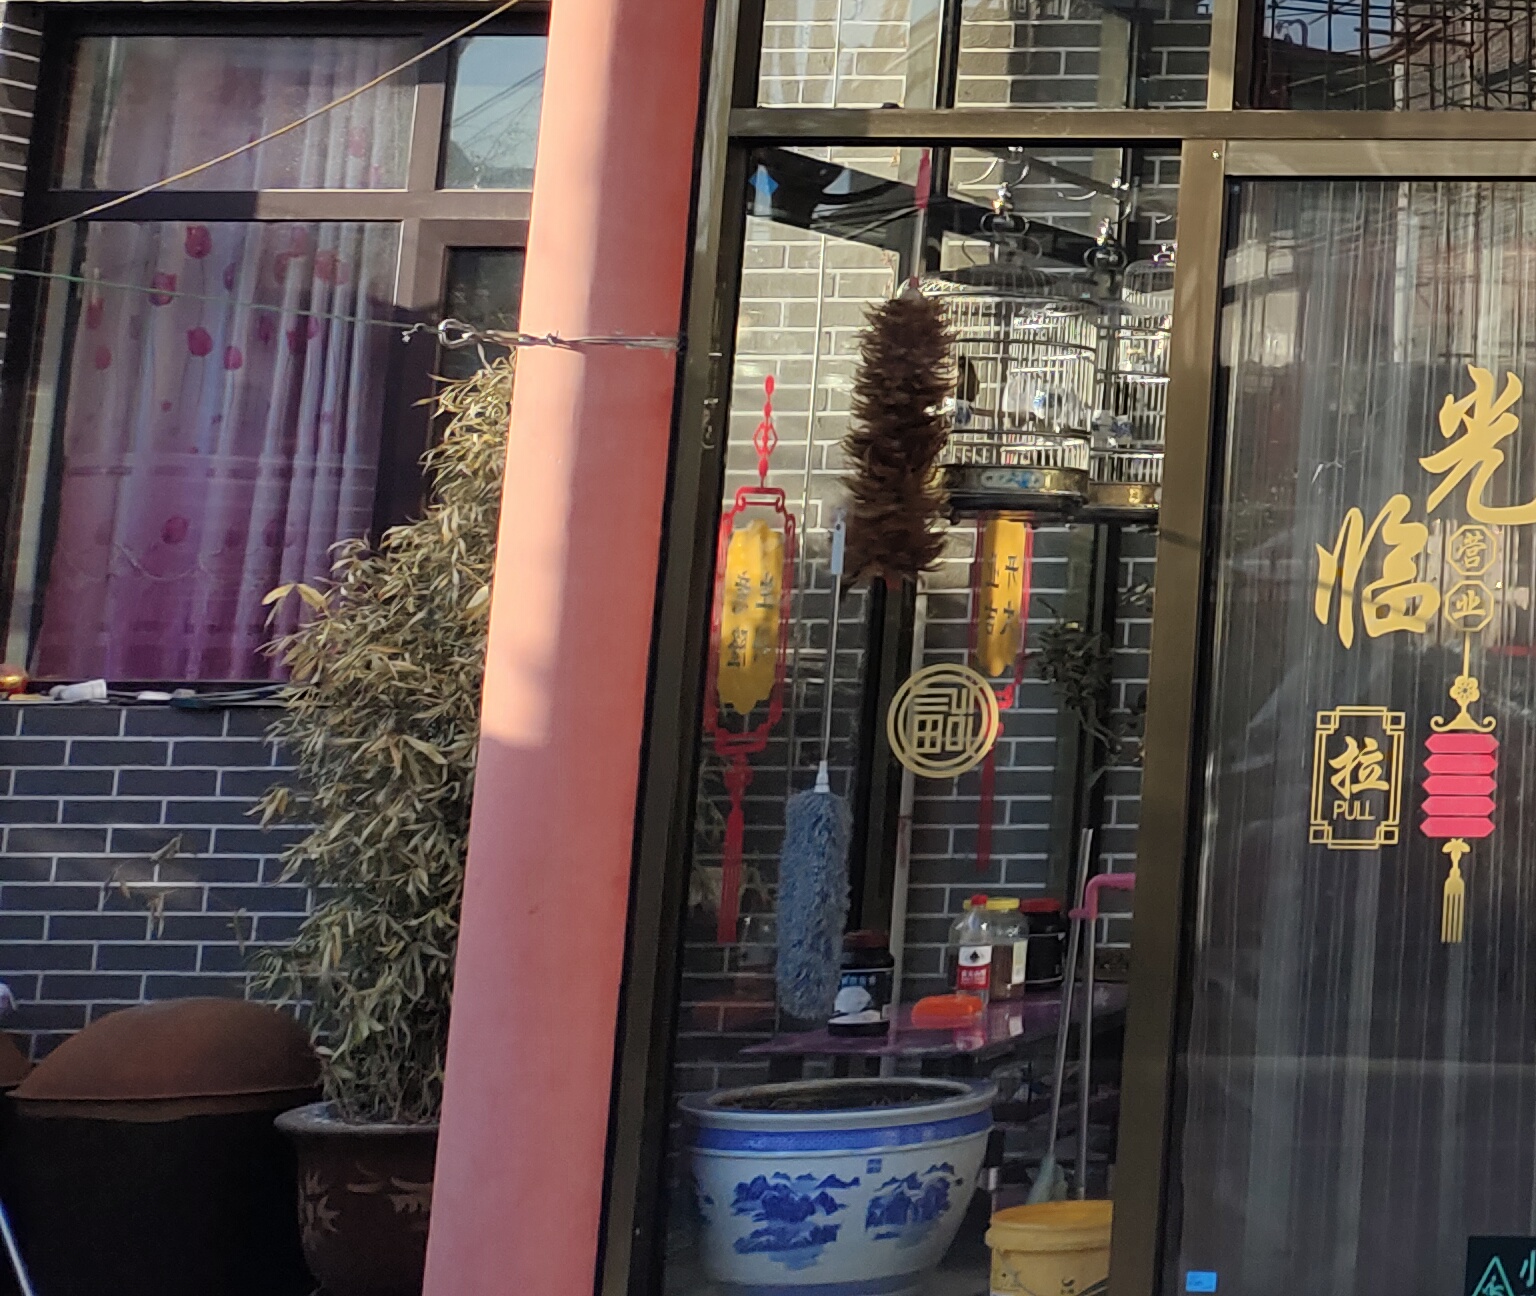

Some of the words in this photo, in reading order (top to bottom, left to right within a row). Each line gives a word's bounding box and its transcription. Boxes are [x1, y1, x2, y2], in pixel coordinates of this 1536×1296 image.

[1454, 534, 1487, 620] 营业
[1330, 736, 1391, 799] 拉
[1333, 800, 1375, 821] PULL
